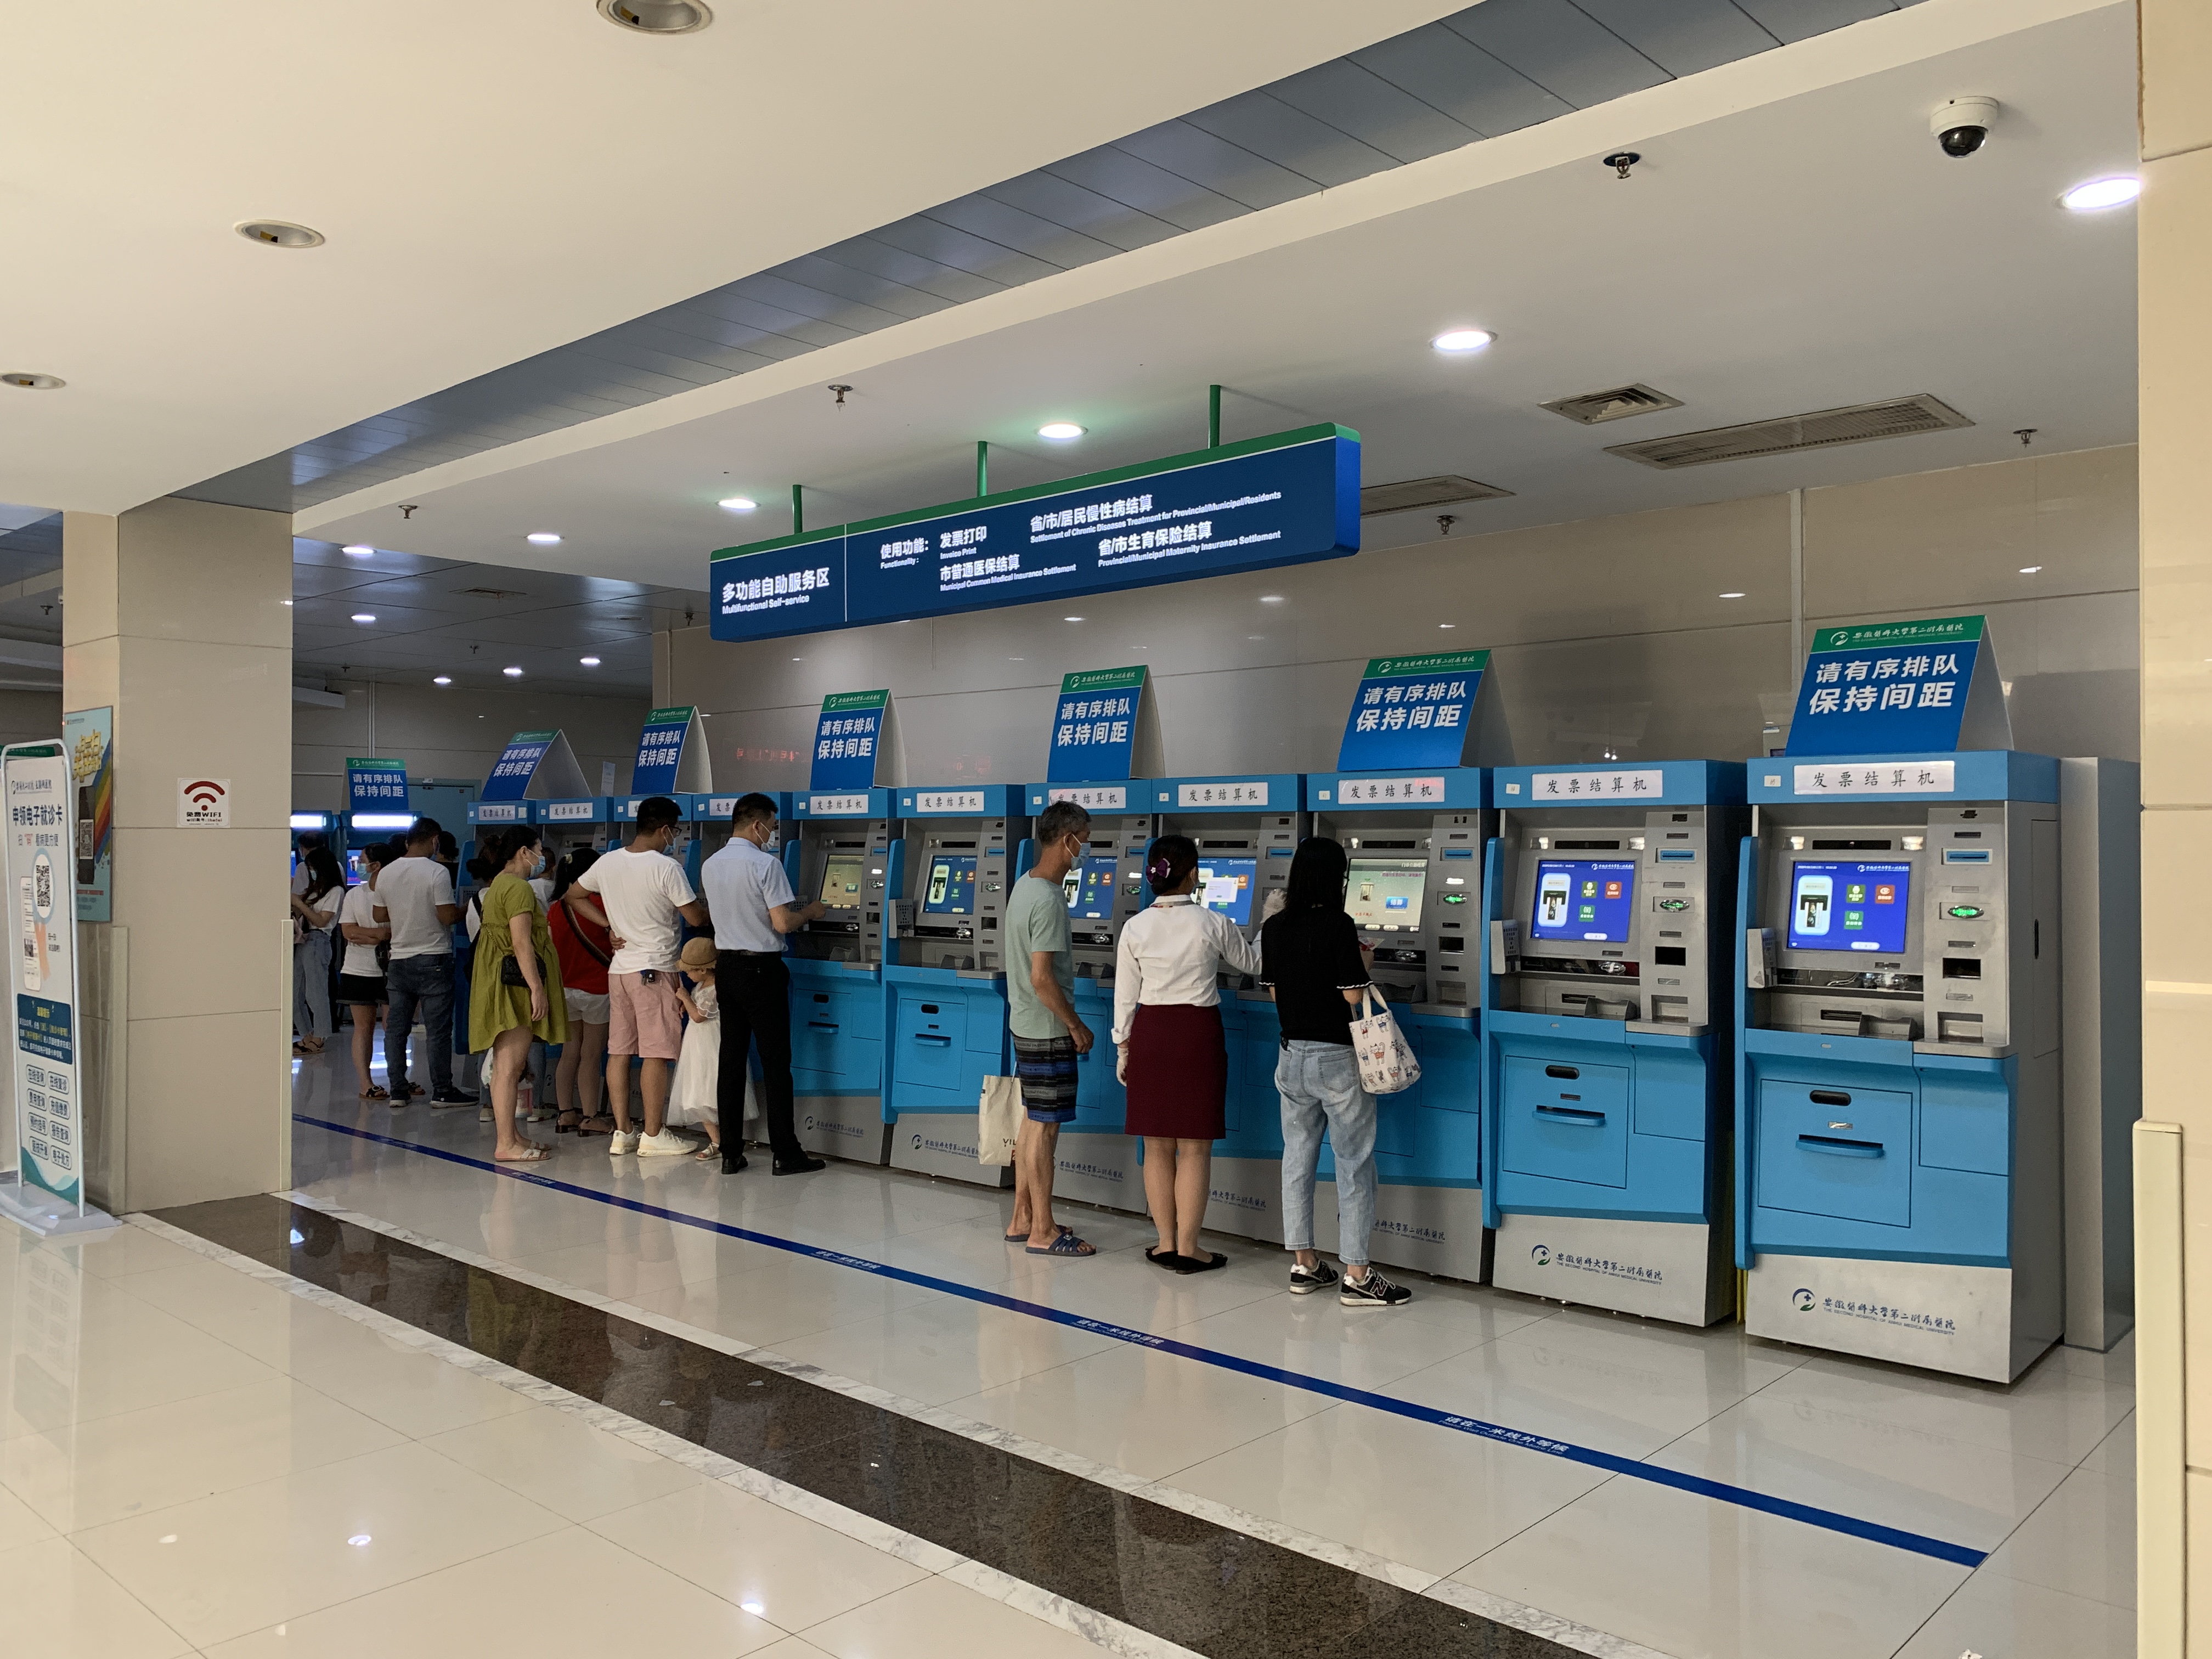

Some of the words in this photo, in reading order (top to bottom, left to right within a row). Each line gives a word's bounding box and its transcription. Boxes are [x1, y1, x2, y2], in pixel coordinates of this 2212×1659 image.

[1030, 494, 1153, 532] 省/市/居民慢性病结算
[1030, 531, 1064, 543] Settlement
[1071, 526, 1096, 537] Chronic
[1097, 521, 1126, 532] Diseases
[1126, 514, 1161, 526] Treatment
[1162, 511, 1172, 520] for
[1173, 492, 1282, 518] Provincial/Municipal/Residents
[939, 525, 988, 549] 发票打印
[1098, 520, 1212, 556] 省/市生育保险结算
[940, 550, 961, 560] Invoice
[962, 546, 977, 556] Print
[1098, 549, 1165, 567] Provincial/Municipal
[1165, 544, 1200, 557] Maternity
[1201, 538, 1238, 551] Insurance
[1239, 531, 1282, 545] Settlement
[939, 554, 1020, 582] 市普通医保结算
[940, 581, 966, 591] Municipal
[966, 577, 991, 588] Common
[991, 573, 1013, 584] Medical
[1013, 569, 1042, 581] Insurance
[1043, 563, 1076, 576] Settlement
[722, 567, 830, 603] 多功能自助服务区
[722, 599, 768, 614] Multifunctional
[769, 594, 809, 608] Self-service
[1816, 653, 1959, 683] 请有序排队
[1363, 681, 1466, 705] 请有序排队
[1809, 681, 1956, 715] 保持间距
[1061, 697, 1130, 720] 请有序排队
[1356, 704, 1463, 732] 保持间距
[821, 716, 875, 736] 请有序排队
[1057, 721, 1128, 747] 保持间距
[642, 730, 681, 746] 请有序排队
[818, 737, 873, 760] 保持间距
[501, 747, 542, 760] 请有序排队
[638, 748, 678, 768] 保持间距
[353, 772, 403, 783] 请有序排队
[493, 761, 535, 777] 保持间距
[1813, 769, 1934, 788] 发票结算机
[354, 785, 404, 797] 保持间距
[1188, 788, 1257, 801] 发票结算机
[1350, 783, 1432, 798] 发票结算机
[1547, 776, 1647, 793] 发票结算机
[817, 799, 862, 810] 发票结算机
[925, 796, 977, 808] 发票结算机
[13, 804, 63, 826] 申领电子就诊卡
[1639, 1278, 1662, 1286] UNIVERSITY
[1855, 1313, 1877, 1322] HOSPITAL
[1926, 1327, 1955, 1336] UNIVERSITY
[1444, 1416, 1570, 1452] 请在一米线外等候
[1480, 1430, 1507, 1440] Outside
